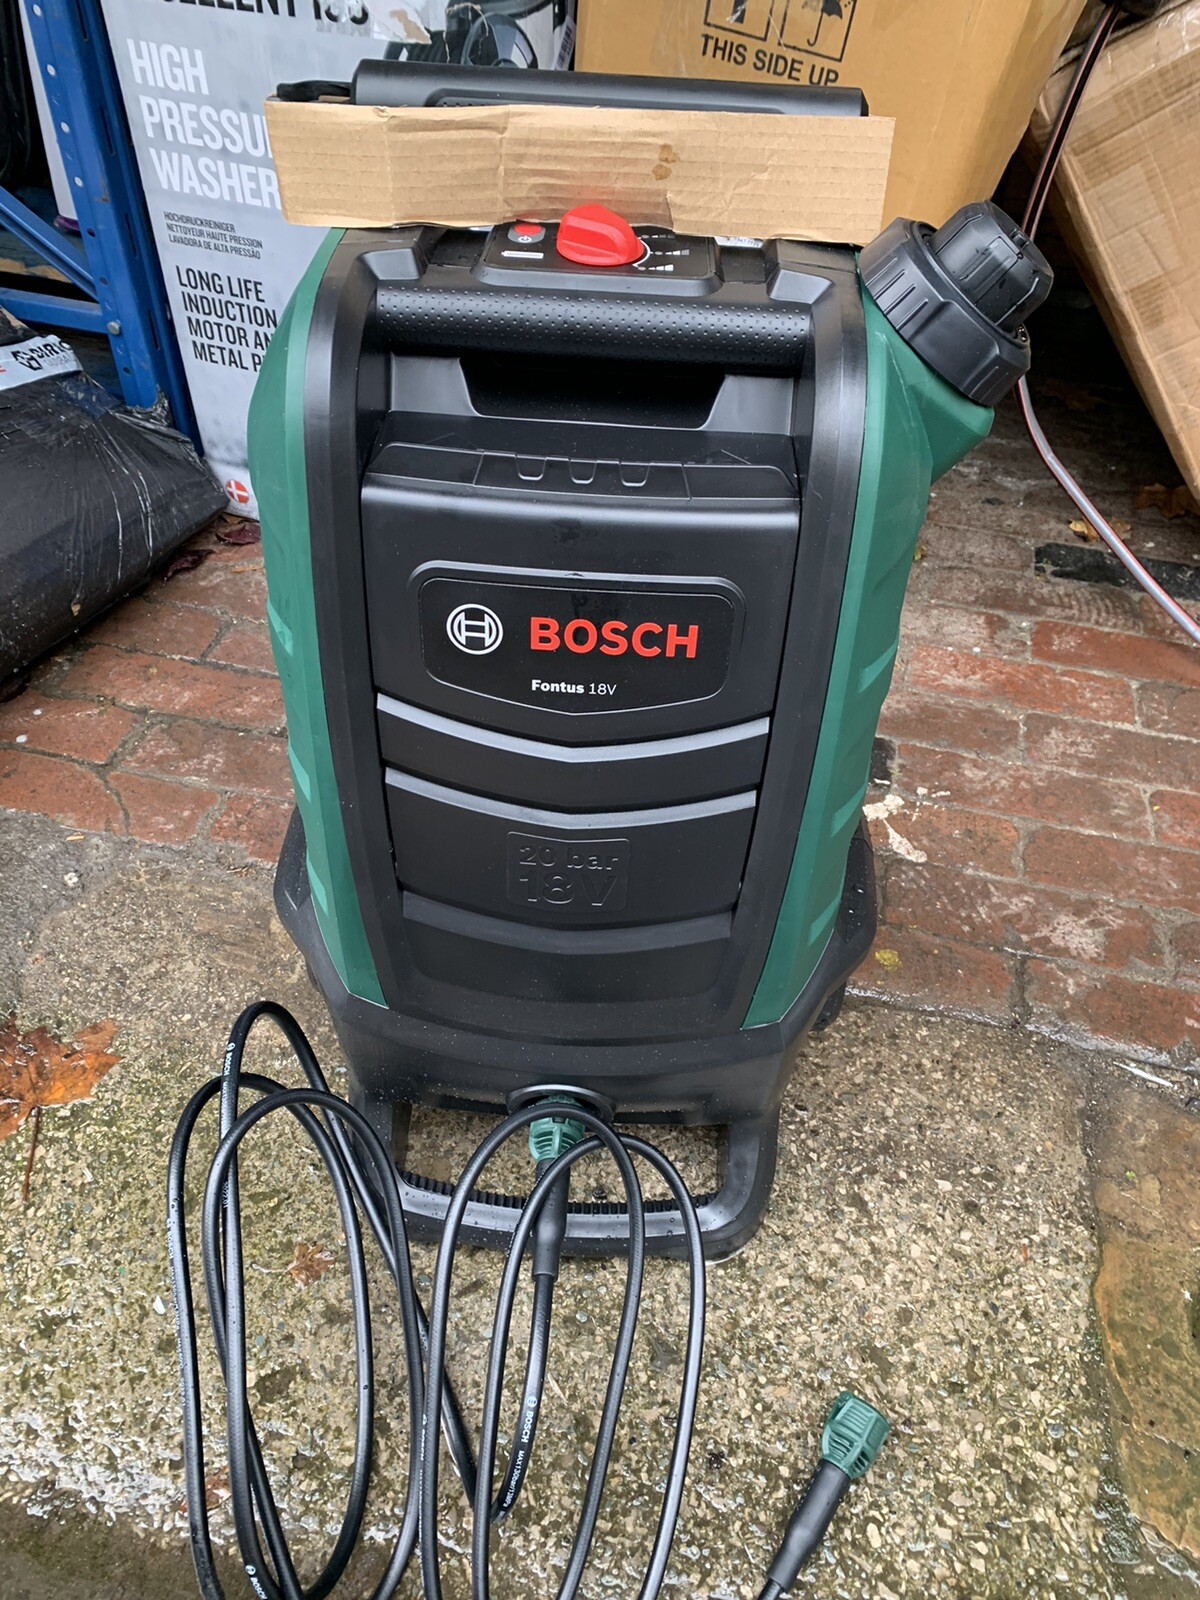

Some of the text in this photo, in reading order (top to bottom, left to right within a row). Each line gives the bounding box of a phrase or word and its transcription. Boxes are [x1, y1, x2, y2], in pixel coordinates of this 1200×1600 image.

[126, 38, 209, 95] HIGH
[701, 33, 839, 86] THIS SIDE UP
[139, 95, 273, 158] PRESSU
[149, 147, 282, 210] WASHER
[163, 210, 236, 233] HOCHDRUCKREINIGER
[166, 222, 263, 249] NETTOYEUR HAUTE PRESSION
[168, 234, 203, 248] LAVADORA
[203, 241, 212, 250] DE
[213, 242, 230, 254] ALTA
[176, 265, 265, 303] LONG LIFE
[181, 290, 278, 329] INDUCTION
[186, 315, 274, 351] MOTOR AN
[191, 340, 249, 371] METAL
[530, 616, 699, 659] BOSCH
[531, 679, 617, 696] Fontus 18V
[519, 847, 620, 870] 20 bar
[519, 873, 618, 906] 18V
[521, 1410, 534, 1443] BOSCH
